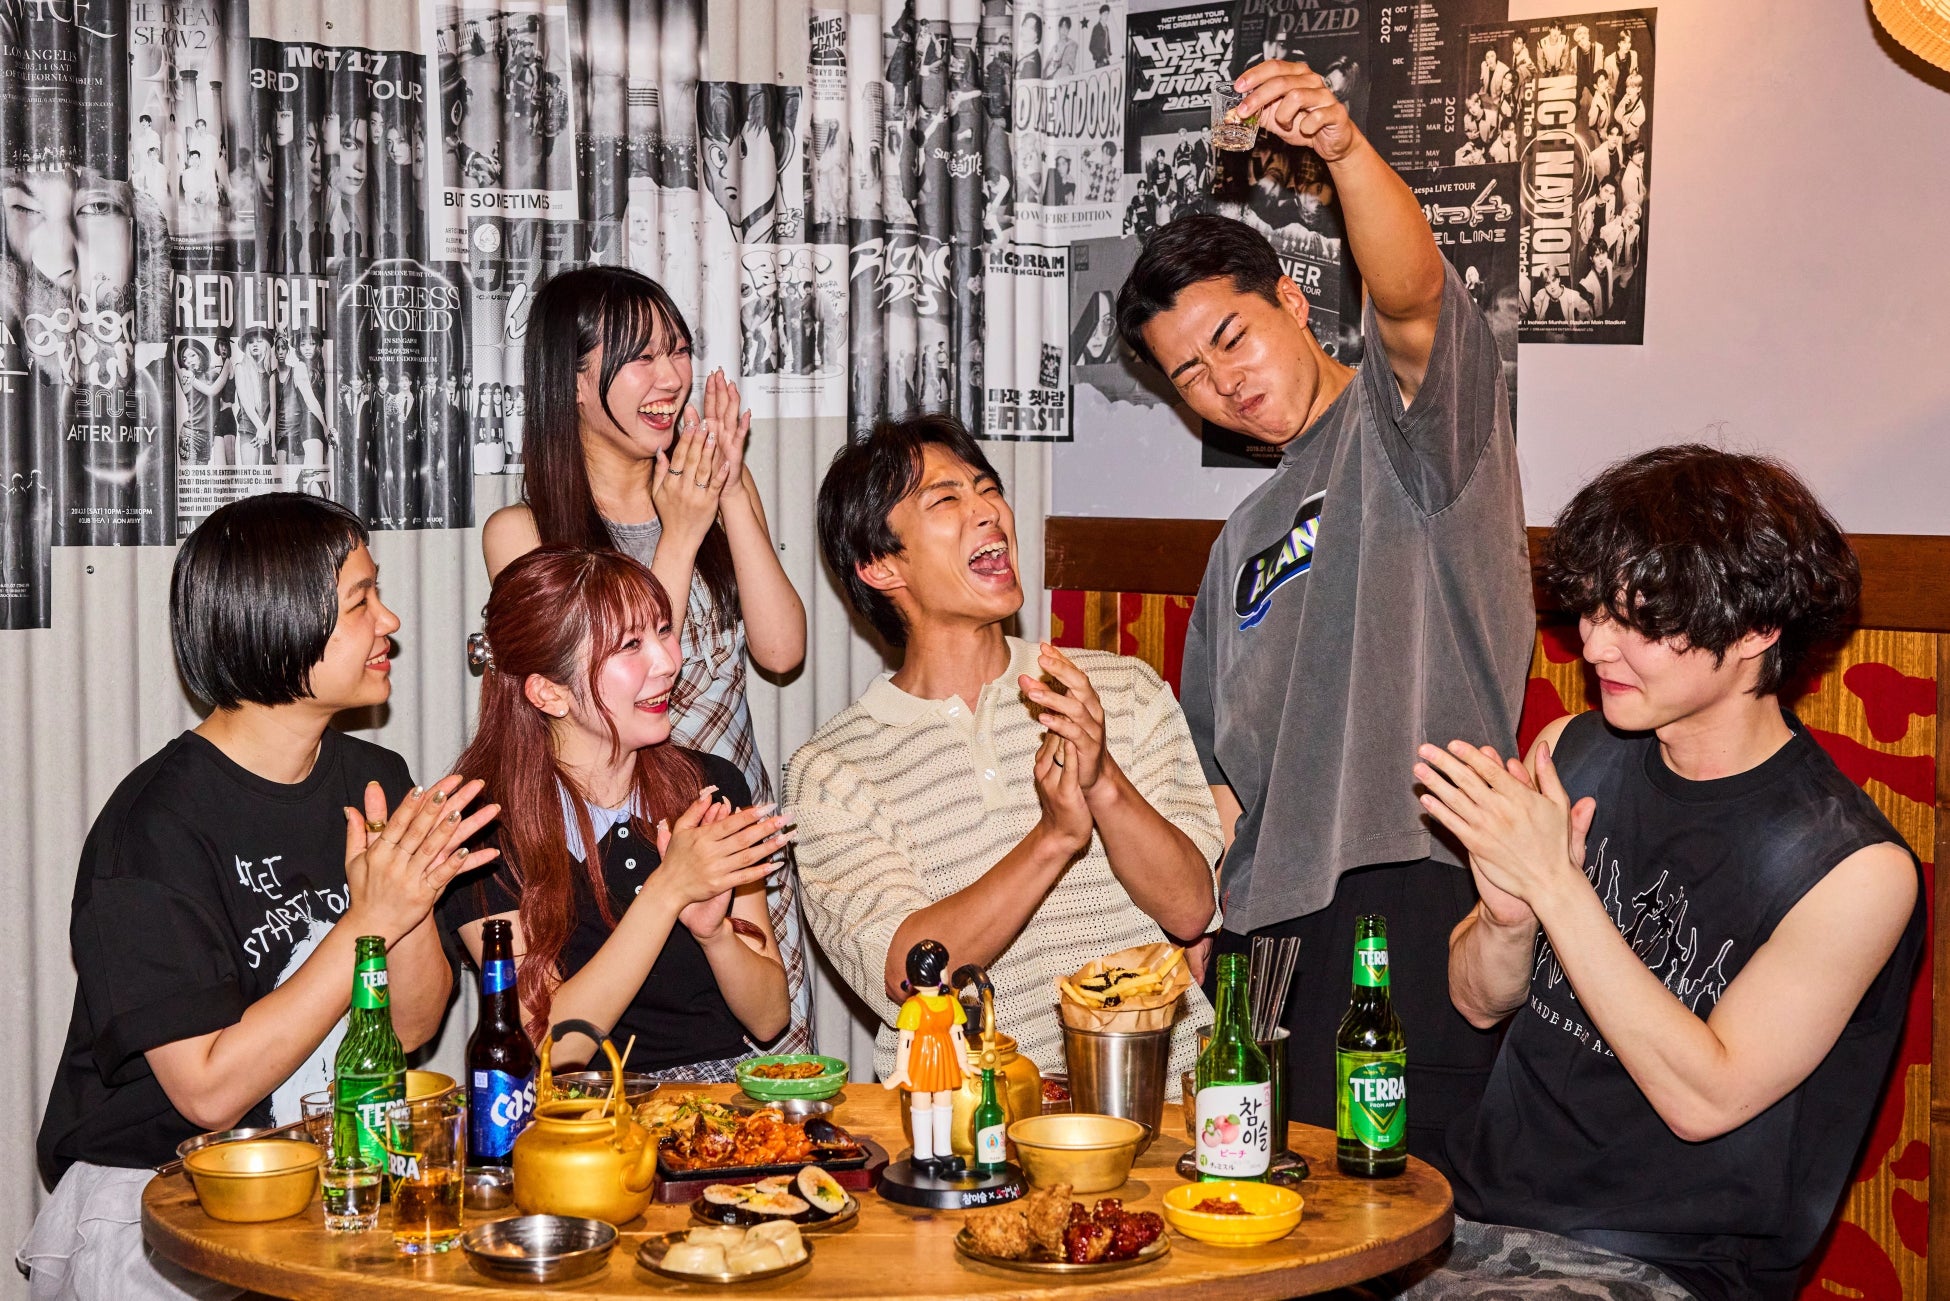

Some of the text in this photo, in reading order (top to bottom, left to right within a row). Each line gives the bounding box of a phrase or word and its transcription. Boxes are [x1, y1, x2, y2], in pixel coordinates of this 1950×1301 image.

[1173, 21, 1198, 29] DREAM
[1199, 17, 1222, 26] SHOW
[1177, 12, 1203, 21] DREAM
[1204, 9, 1225, 18] TOUR
[1280, 8, 1360, 33] DAZED
[1380, 7, 1392, 43] 2022
[817, 31, 847, 51] CAMP
[1392, 57, 1404, 65] DEC
[250, 68, 424, 103] 3RD TOUR
[1429, 97, 1443, 105] JAN
[1536, 75, 1577, 146] NCT
[1444, 96, 1456, 133] 2023
[1522, 102, 1536, 138] The
[1425, 149, 1440, 157] MAY
[1413, 182, 1476, 195] aespa LIVE TOUR
[1072, 208, 1113, 223] EDITION
[1460, 228, 1507, 244] LINE
[1278, 257, 1322, 288] NER
[1302, 285, 1322, 296] TOUR
[175, 274, 235, 329] RED
[244, 276, 330, 331] LIGHT
[997, 406, 1065, 431] FRST
[66, 423, 112, 442] AFTER
[1358, 950, 1389, 968] TERR
[1349, 1075, 1406, 1103] TERRA
[1220, 1149, 1247, 1159] ピーチ
[387, 1153, 421, 1181] RRA
